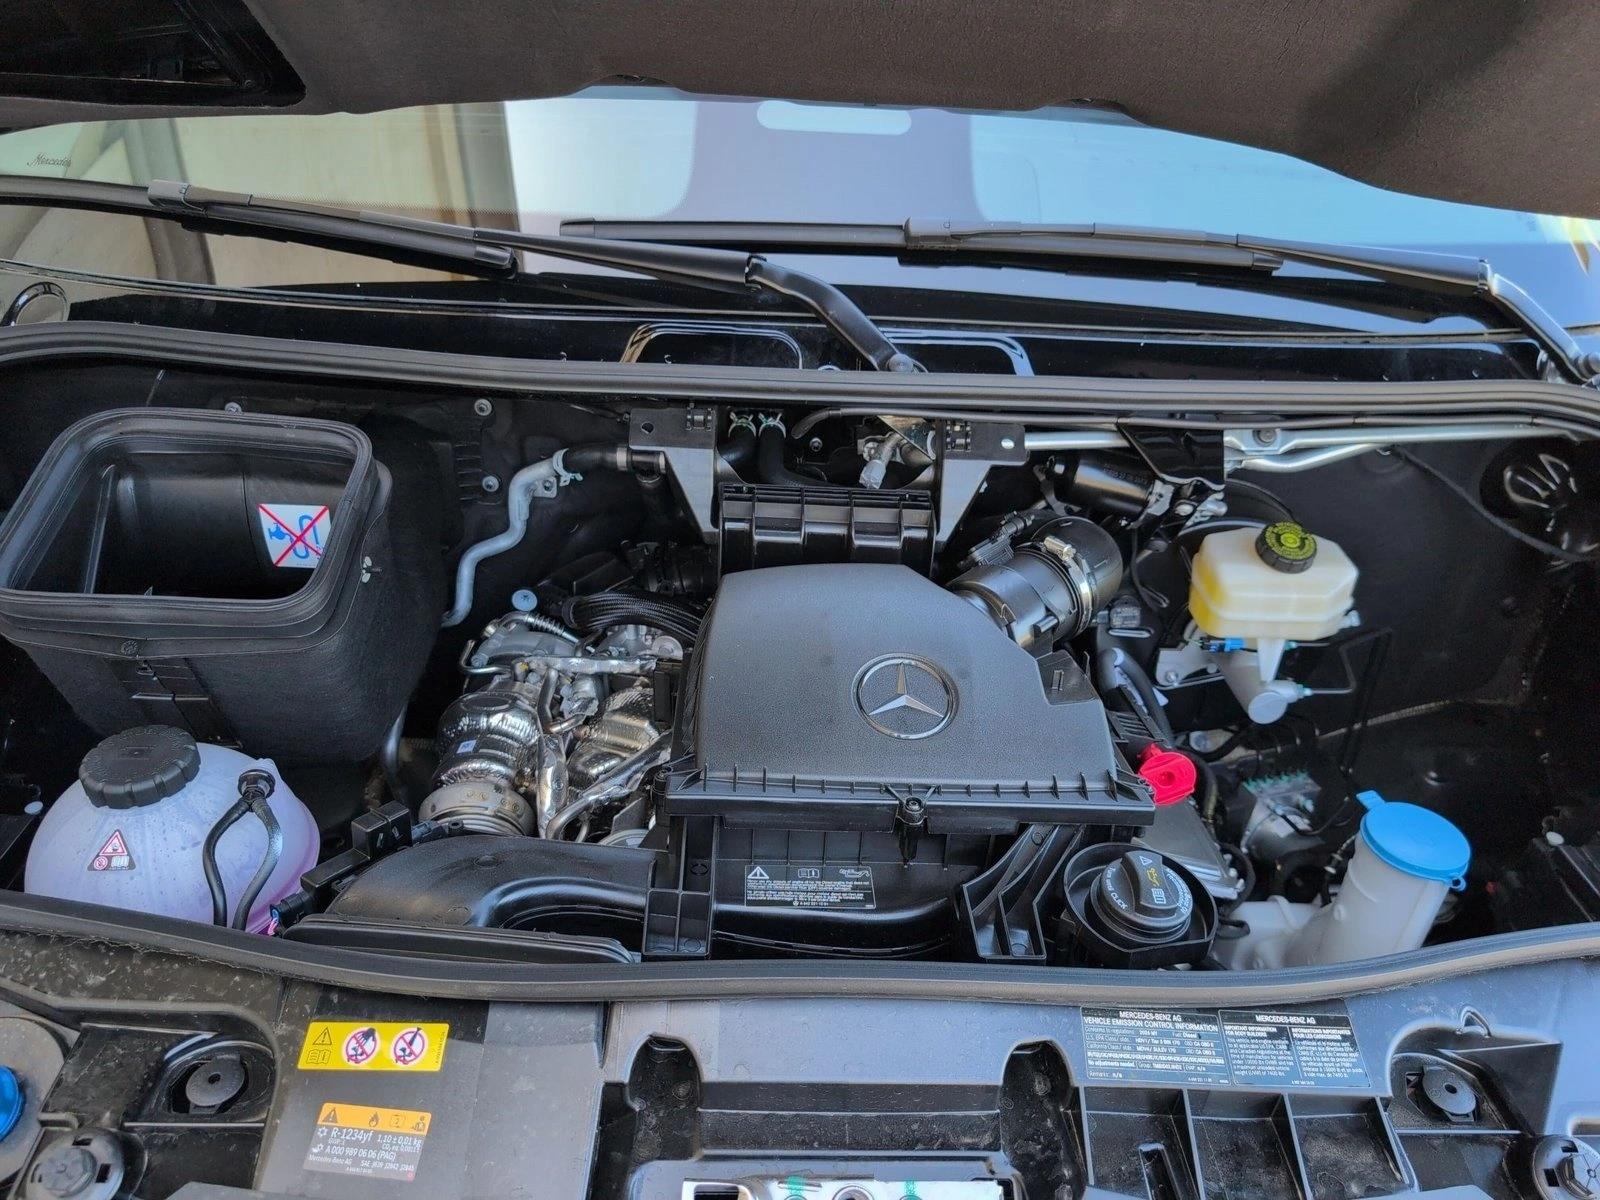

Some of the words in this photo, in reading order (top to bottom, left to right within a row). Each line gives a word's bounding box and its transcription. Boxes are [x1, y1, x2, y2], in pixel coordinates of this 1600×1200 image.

[1110, 892, 1128, 910] CLICK
[1120, 1011, 1171, 1021] MERCEDES-BENZ
[1256, 1014, 1306, 1024] MERCEDES-BENZ
[1307, 1016, 1316, 1024] AG
[1084, 1017, 1111, 1025] VEHICLE
[1112, 1018, 1143, 1027] EMISSION
[1144, 1020, 1174, 1029] CONTROL
[1175, 1023, 1218, 1032] INFORMATION
[330, 1127, 373, 1144] R-1234yf
[331, 1146, 344, 1155] 000
[345, 1148, 357, 1156] 989
[358, 1149, 366, 1157] 06
[377, 1150, 396, 1161] (PAG)
